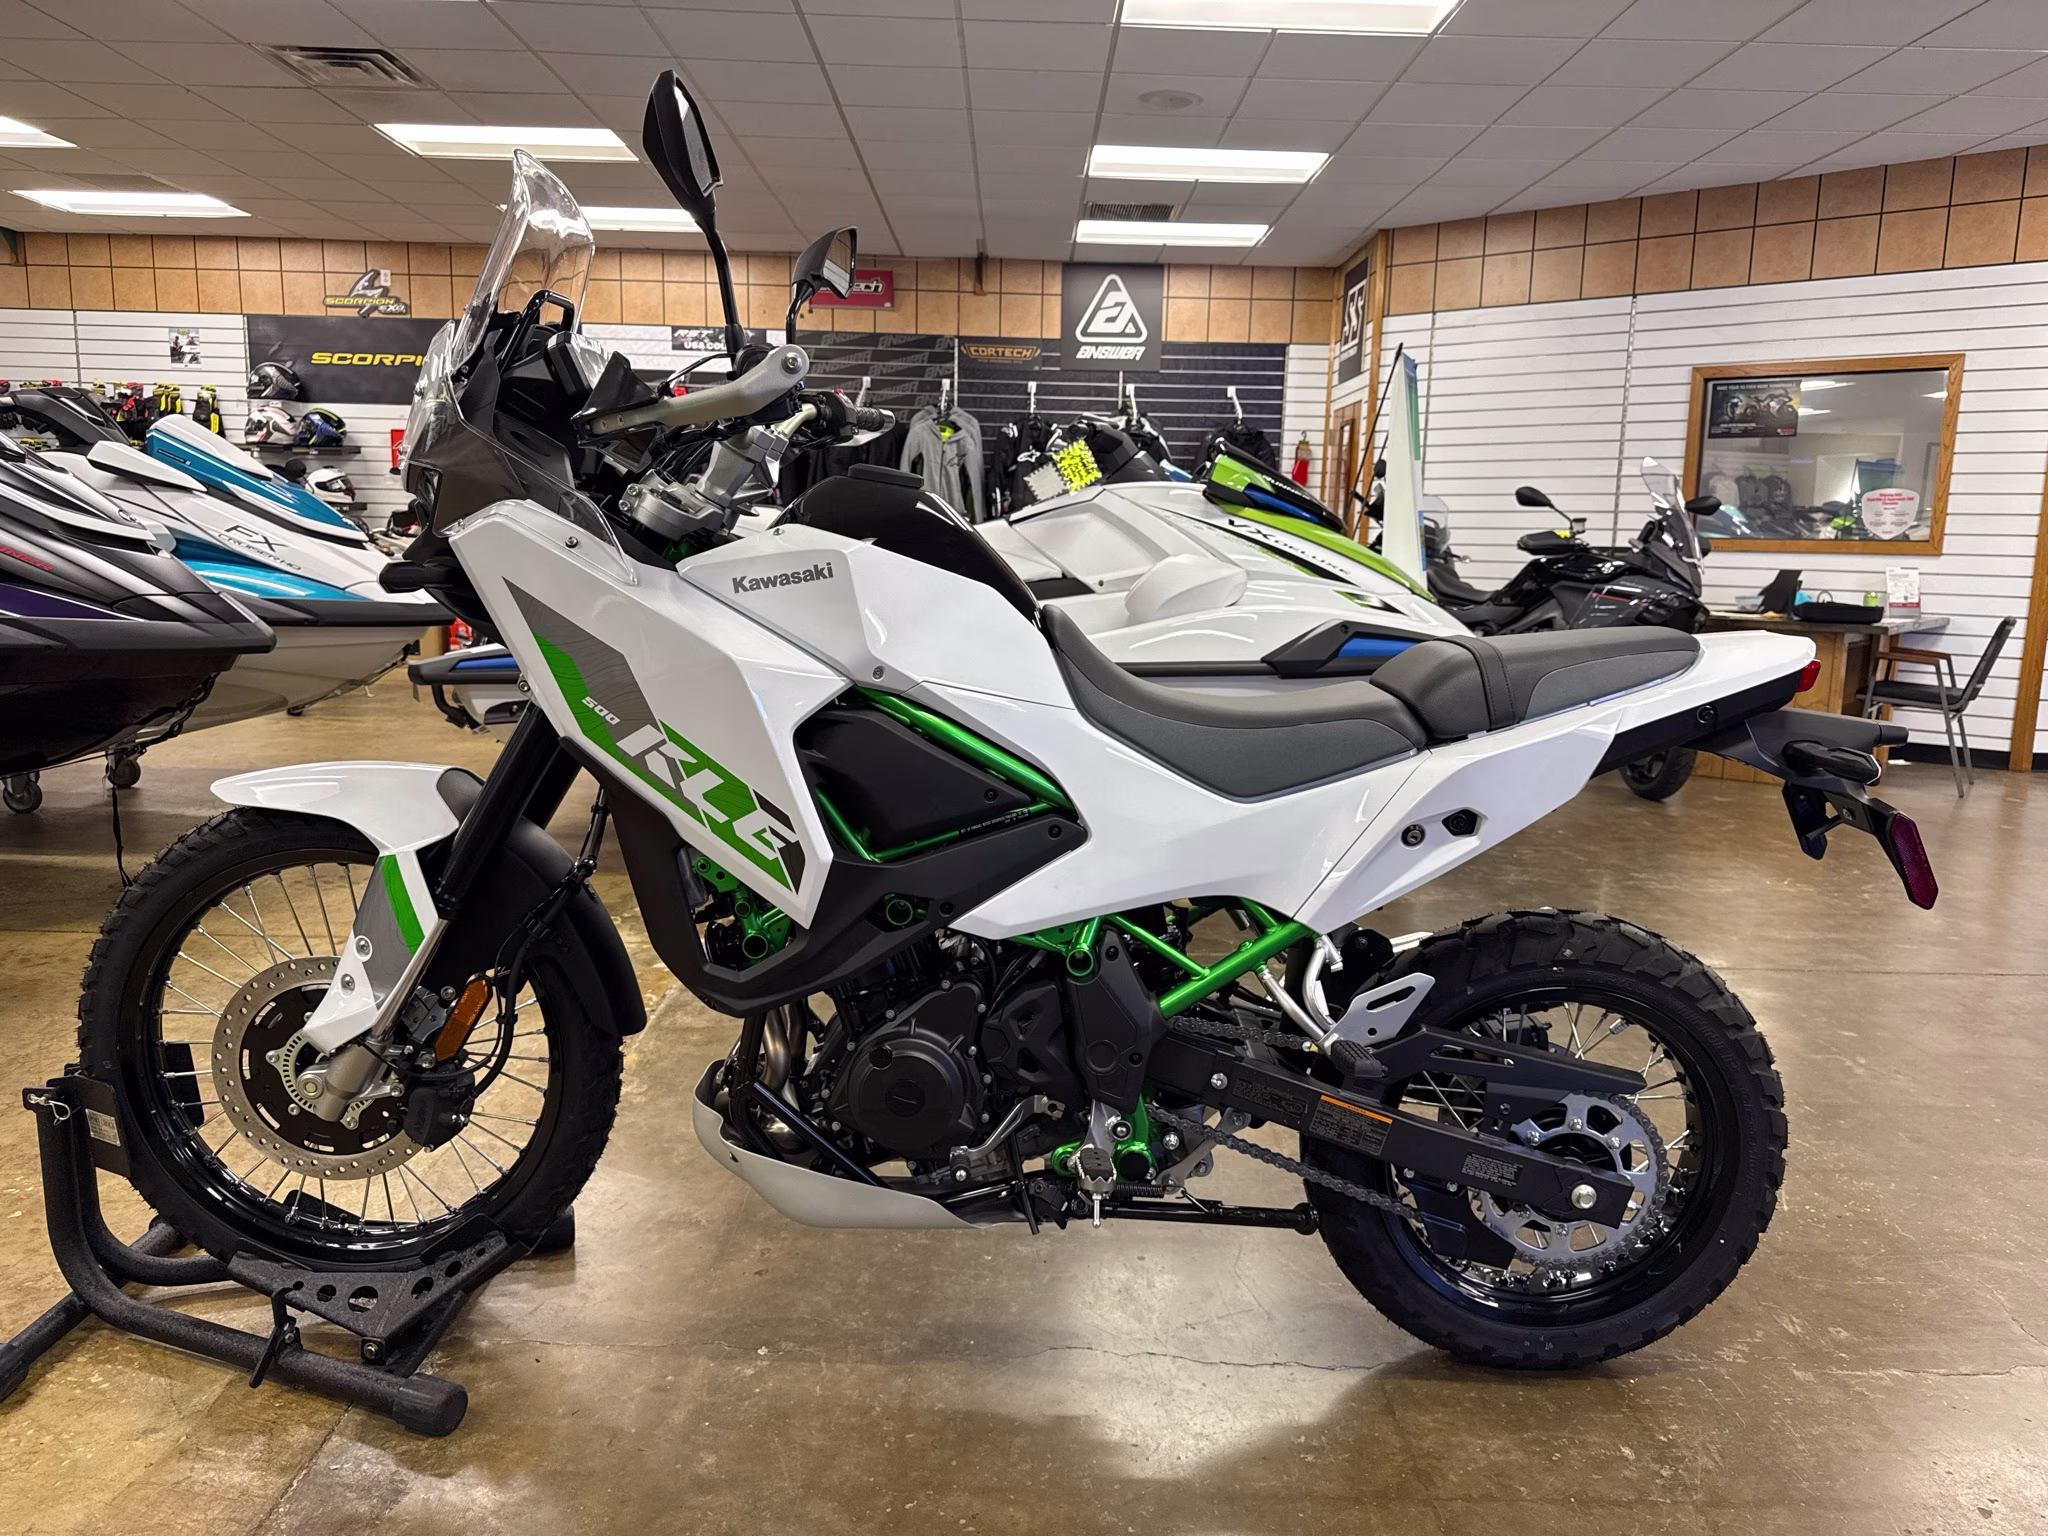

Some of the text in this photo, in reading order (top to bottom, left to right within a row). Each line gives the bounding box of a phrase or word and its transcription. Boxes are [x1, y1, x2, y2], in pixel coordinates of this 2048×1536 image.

[325, 297, 395, 305] SCORPION
[684, 341, 705, 350] USA
[969, 345, 1033, 358] CORTECH
[1075, 345, 1146, 360] ANSWER
[311, 352, 427, 366] SCORPI
[224, 524, 290, 553] FX
[1227, 518, 1352, 576] VX DELUXE
[731, 561, 834, 594] Kawasaki
[581, 696, 621, 725] 500
[616, 723, 800, 861] KLE
